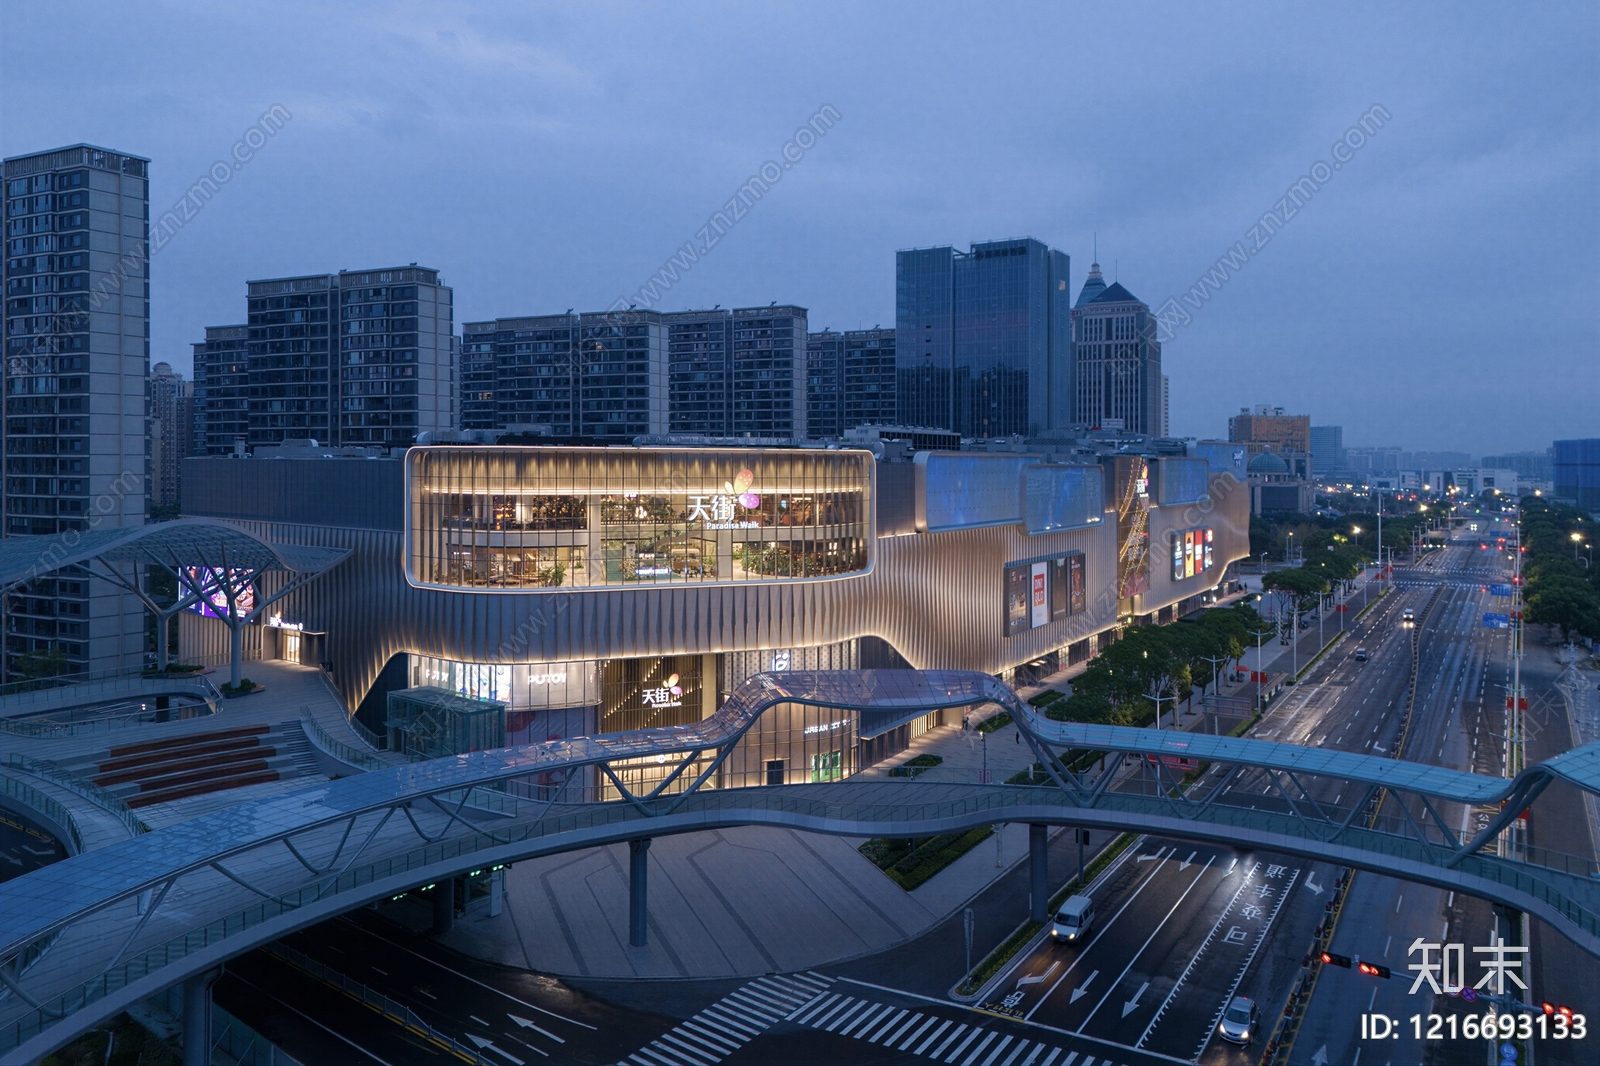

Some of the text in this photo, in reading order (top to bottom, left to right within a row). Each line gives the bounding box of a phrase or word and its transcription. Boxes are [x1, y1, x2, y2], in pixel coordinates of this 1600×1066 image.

[687, 495, 736, 521] 天街
[706, 521, 760, 530] Paradise Walk
[642, 688, 669, 704] 天街
